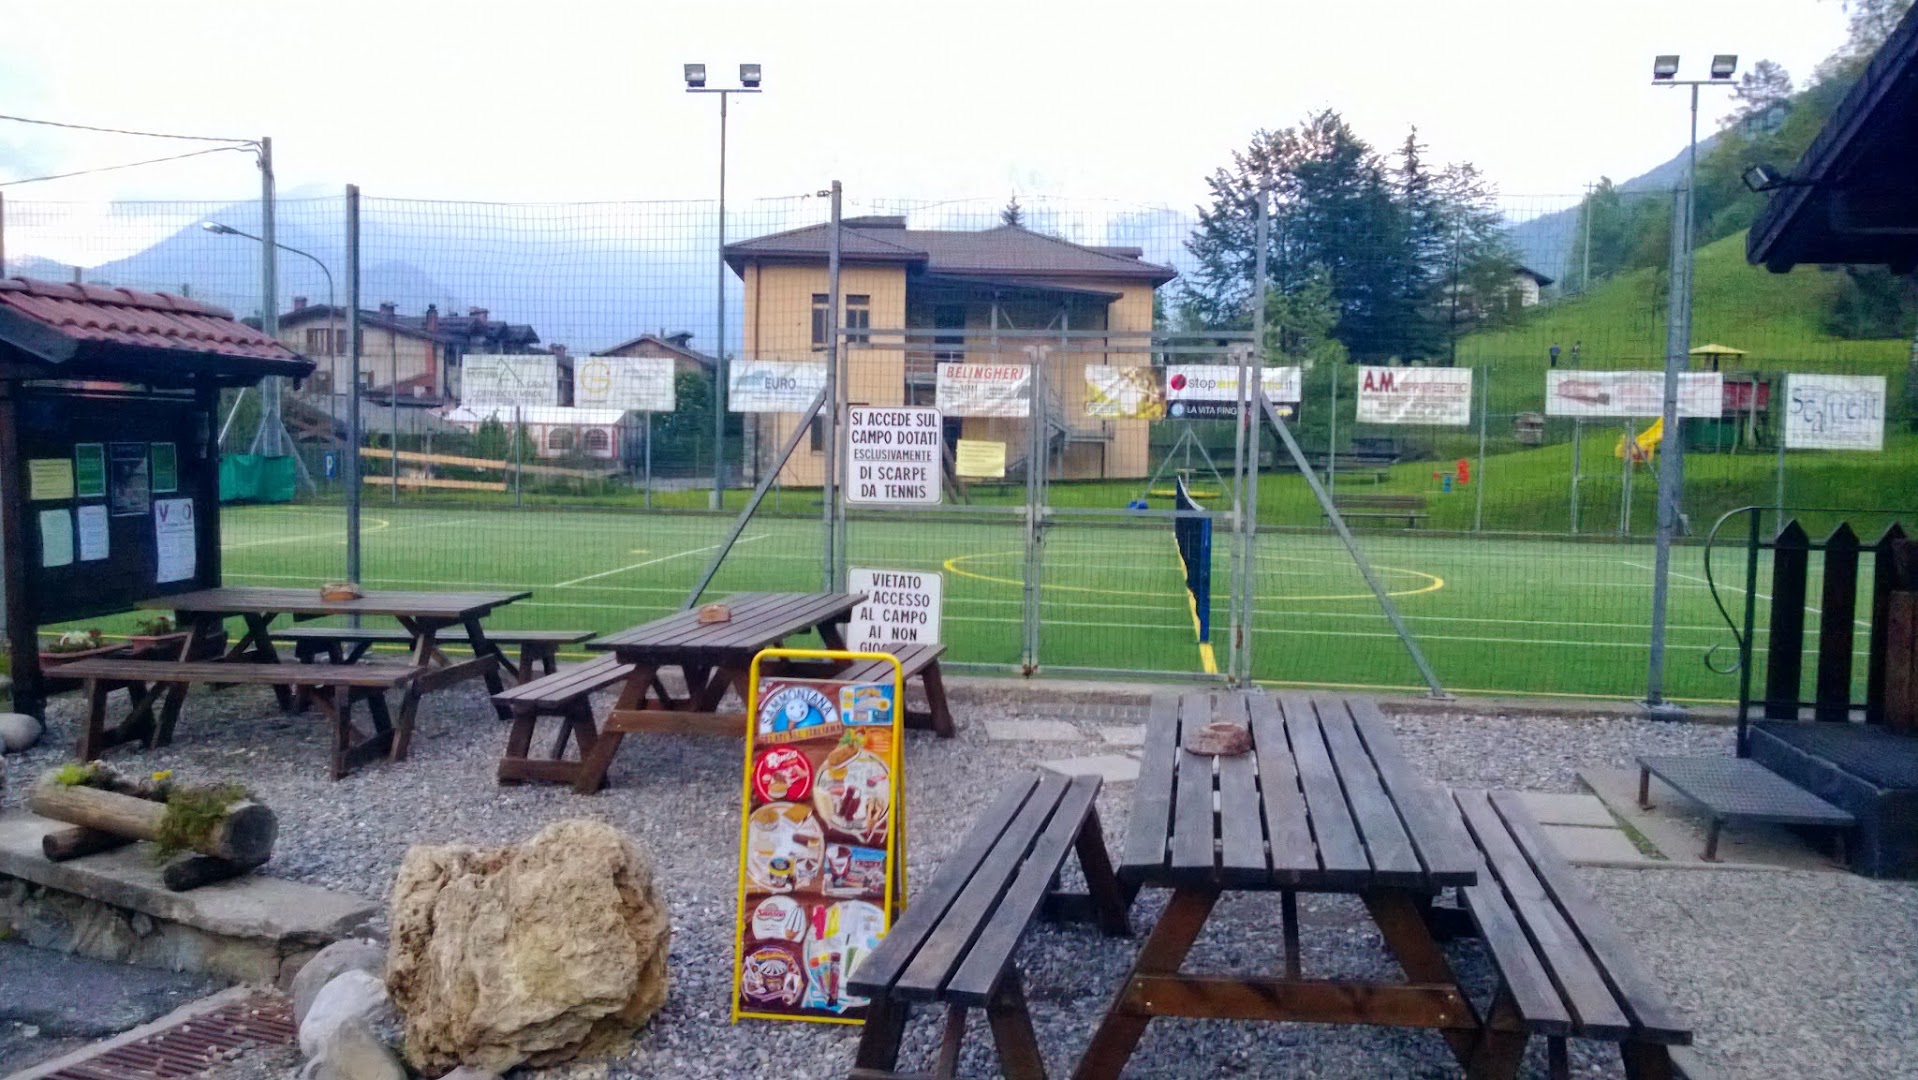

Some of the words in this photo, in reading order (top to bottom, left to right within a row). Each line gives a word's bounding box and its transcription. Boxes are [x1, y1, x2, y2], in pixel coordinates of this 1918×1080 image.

[946, 366, 1025, 380] BELINGHERI
[764, 377, 797, 390] EURO
[852, 412, 863, 426] SI
[868, 412, 912, 427] ACCEDE
[916, 413, 938, 428] SUL
[851, 430, 892, 445] CAMPO
[897, 431, 938, 445] DOTATI
[854, 448, 932, 461] ESCLUSIVAMENTE
[860, 466, 872, 480] DI
[878, 467, 927, 482] SCARPE
[861, 484, 877, 498] DA
[884, 484, 927, 499] TENNIS
[872, 573, 922, 590] VIETATO
[859, 589, 931, 608] 'ACCESSO
[860, 607, 875, 621] AL
[882, 608, 928, 625] CAMPO
[868, 625, 882, 639] AI
[891, 626, 918, 642] NON
